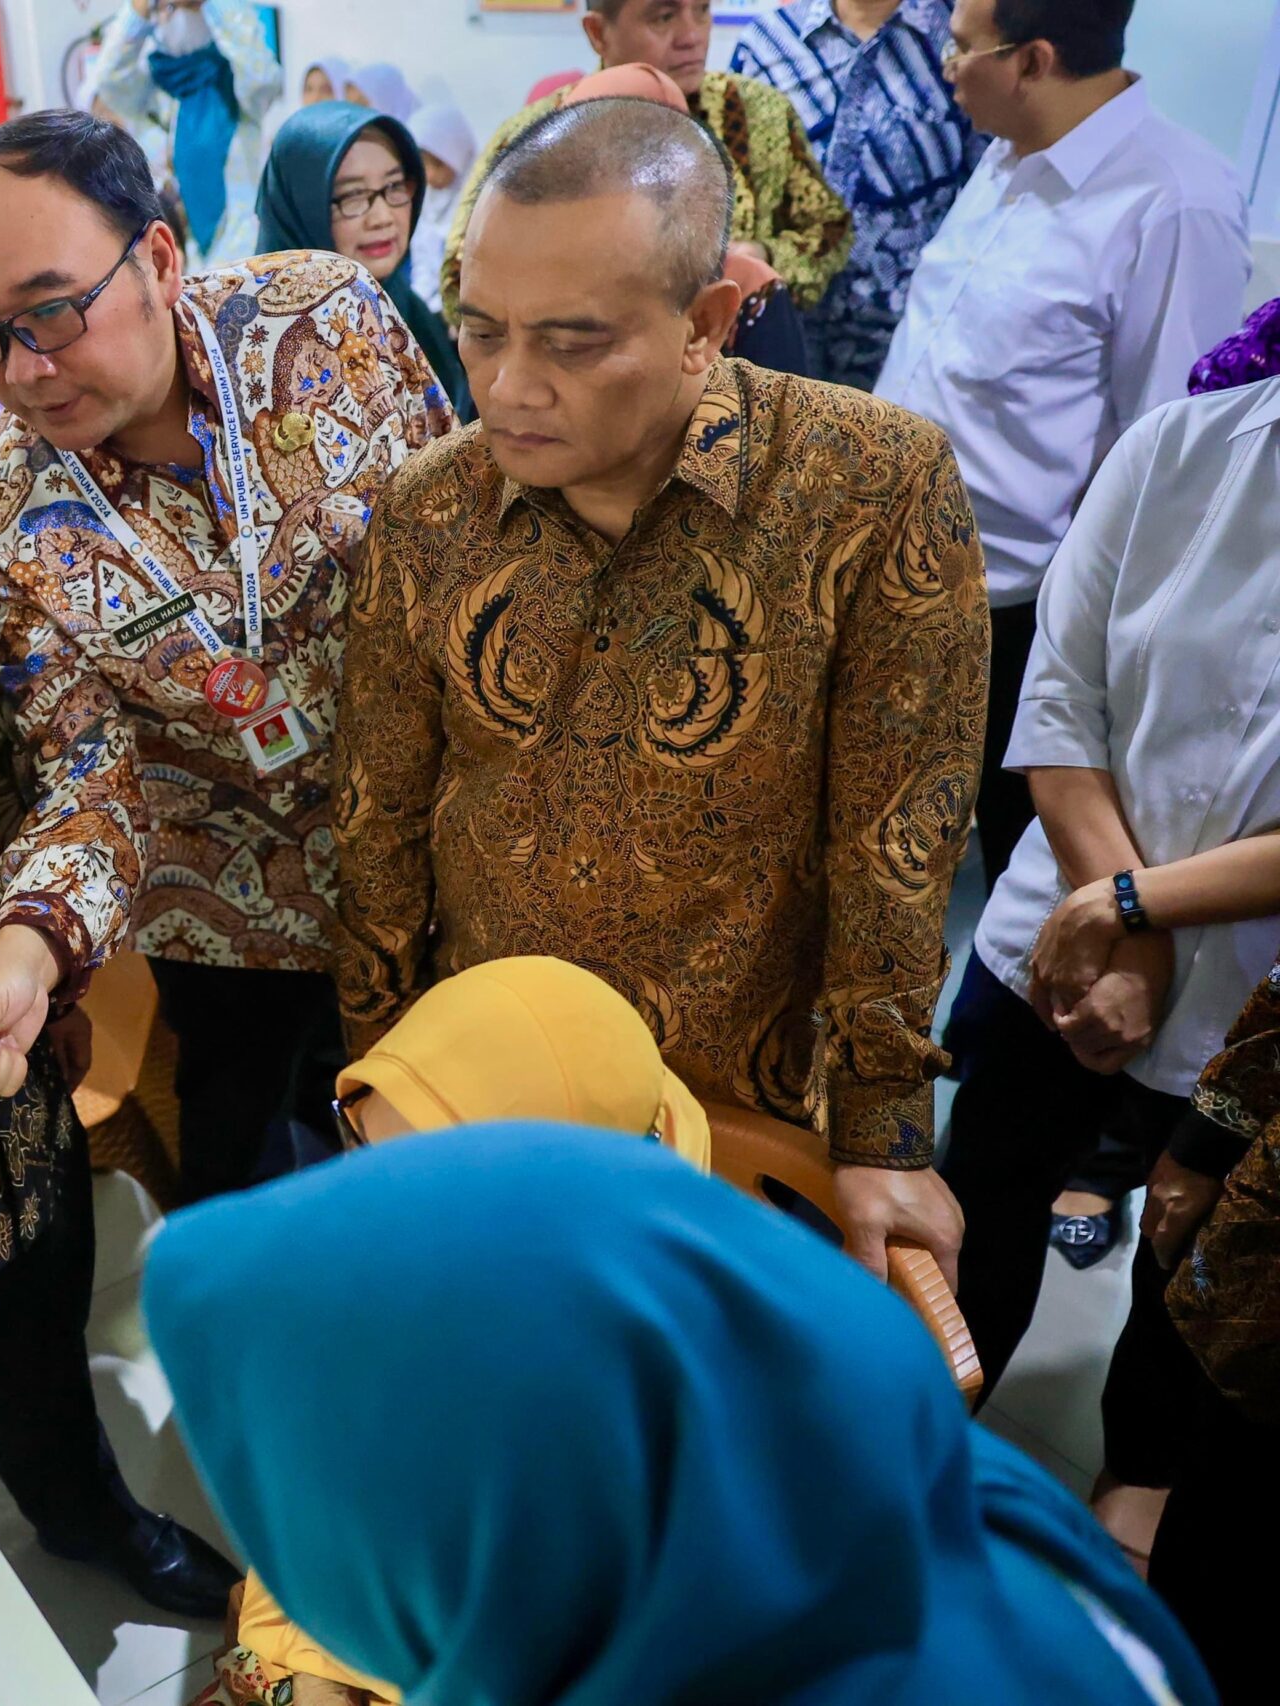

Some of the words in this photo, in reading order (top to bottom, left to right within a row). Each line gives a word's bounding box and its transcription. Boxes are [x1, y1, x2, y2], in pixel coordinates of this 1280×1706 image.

[211, 348, 225, 374] 2024
[219, 376, 234, 415] FORUM
[227, 417, 242, 461] SERVICE
[69, 462, 94, 495] FORUM
[91, 493, 112, 518] 2024
[234, 464, 247, 502] PUBLIC
[239, 504, 250, 520] UN
[142, 555, 156, 572] UN
[246, 573, 257, 599] 2024
[121, 632, 133, 641] M.
[133, 616, 160, 635] ABDUL
[160, 598, 191, 620] HAKAM
